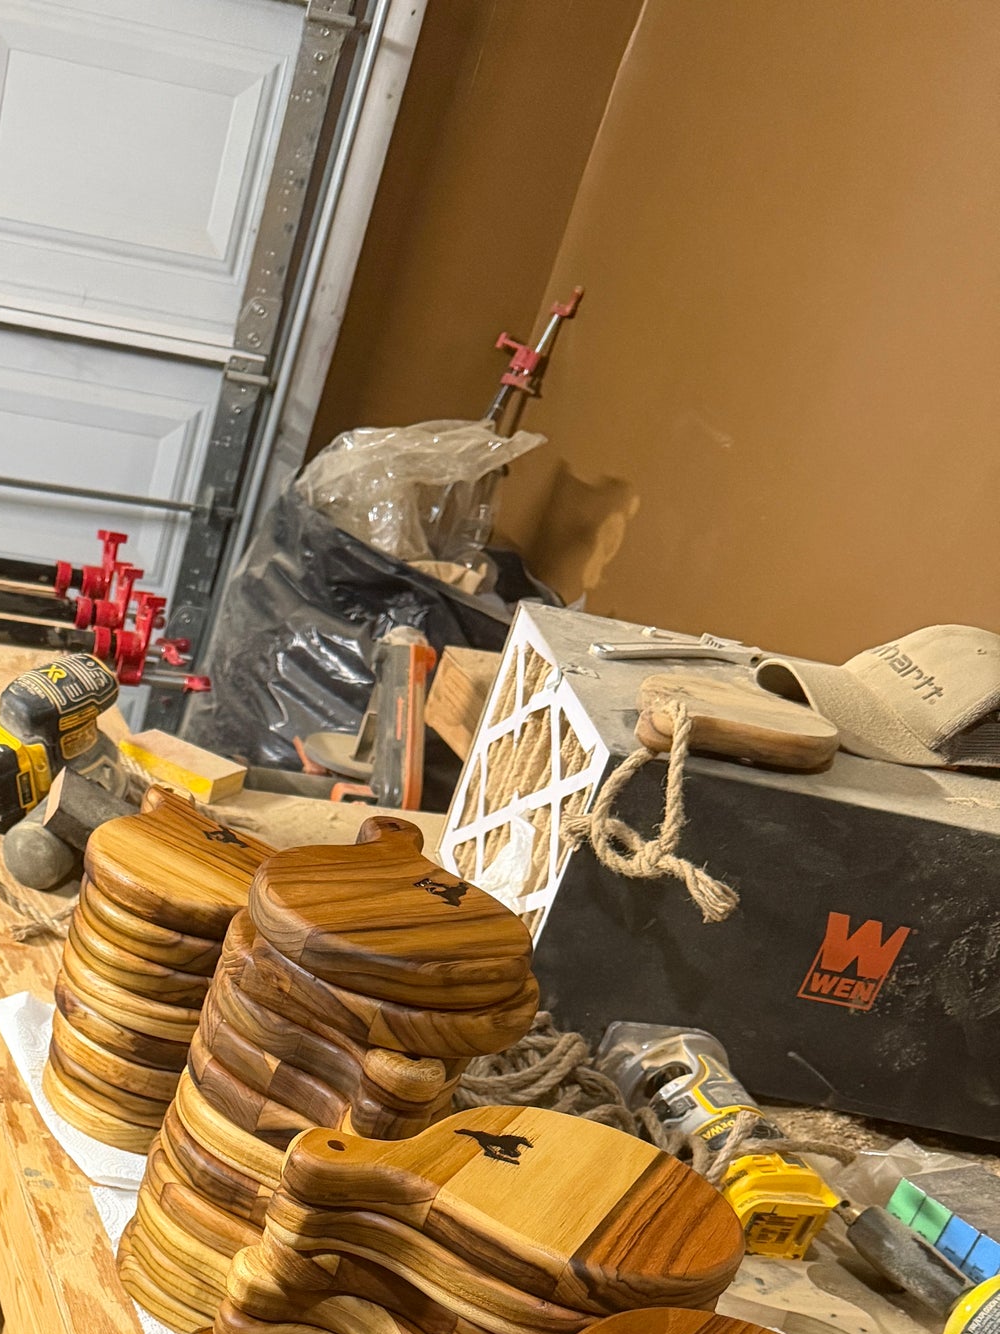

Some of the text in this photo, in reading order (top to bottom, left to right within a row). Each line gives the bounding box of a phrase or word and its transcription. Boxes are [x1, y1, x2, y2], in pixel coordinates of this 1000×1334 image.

[40, 664, 67, 684] XR
[871, 644, 944, 701] hartt
[809, 972, 876, 1003] WEN
